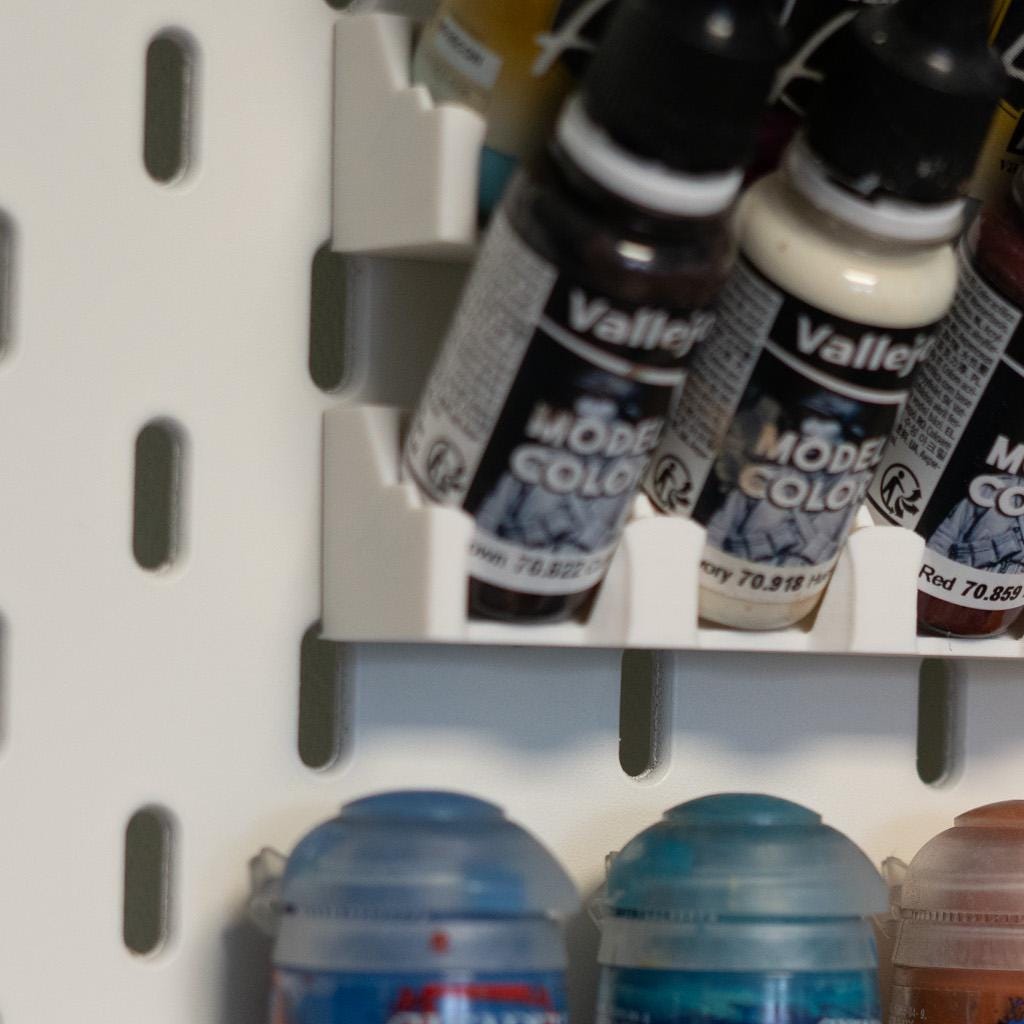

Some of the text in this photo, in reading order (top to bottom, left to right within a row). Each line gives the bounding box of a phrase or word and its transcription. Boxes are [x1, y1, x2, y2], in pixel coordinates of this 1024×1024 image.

[738, 568, 805, 592] 70.918
[918, 563, 1023, 602] Red 70.859
